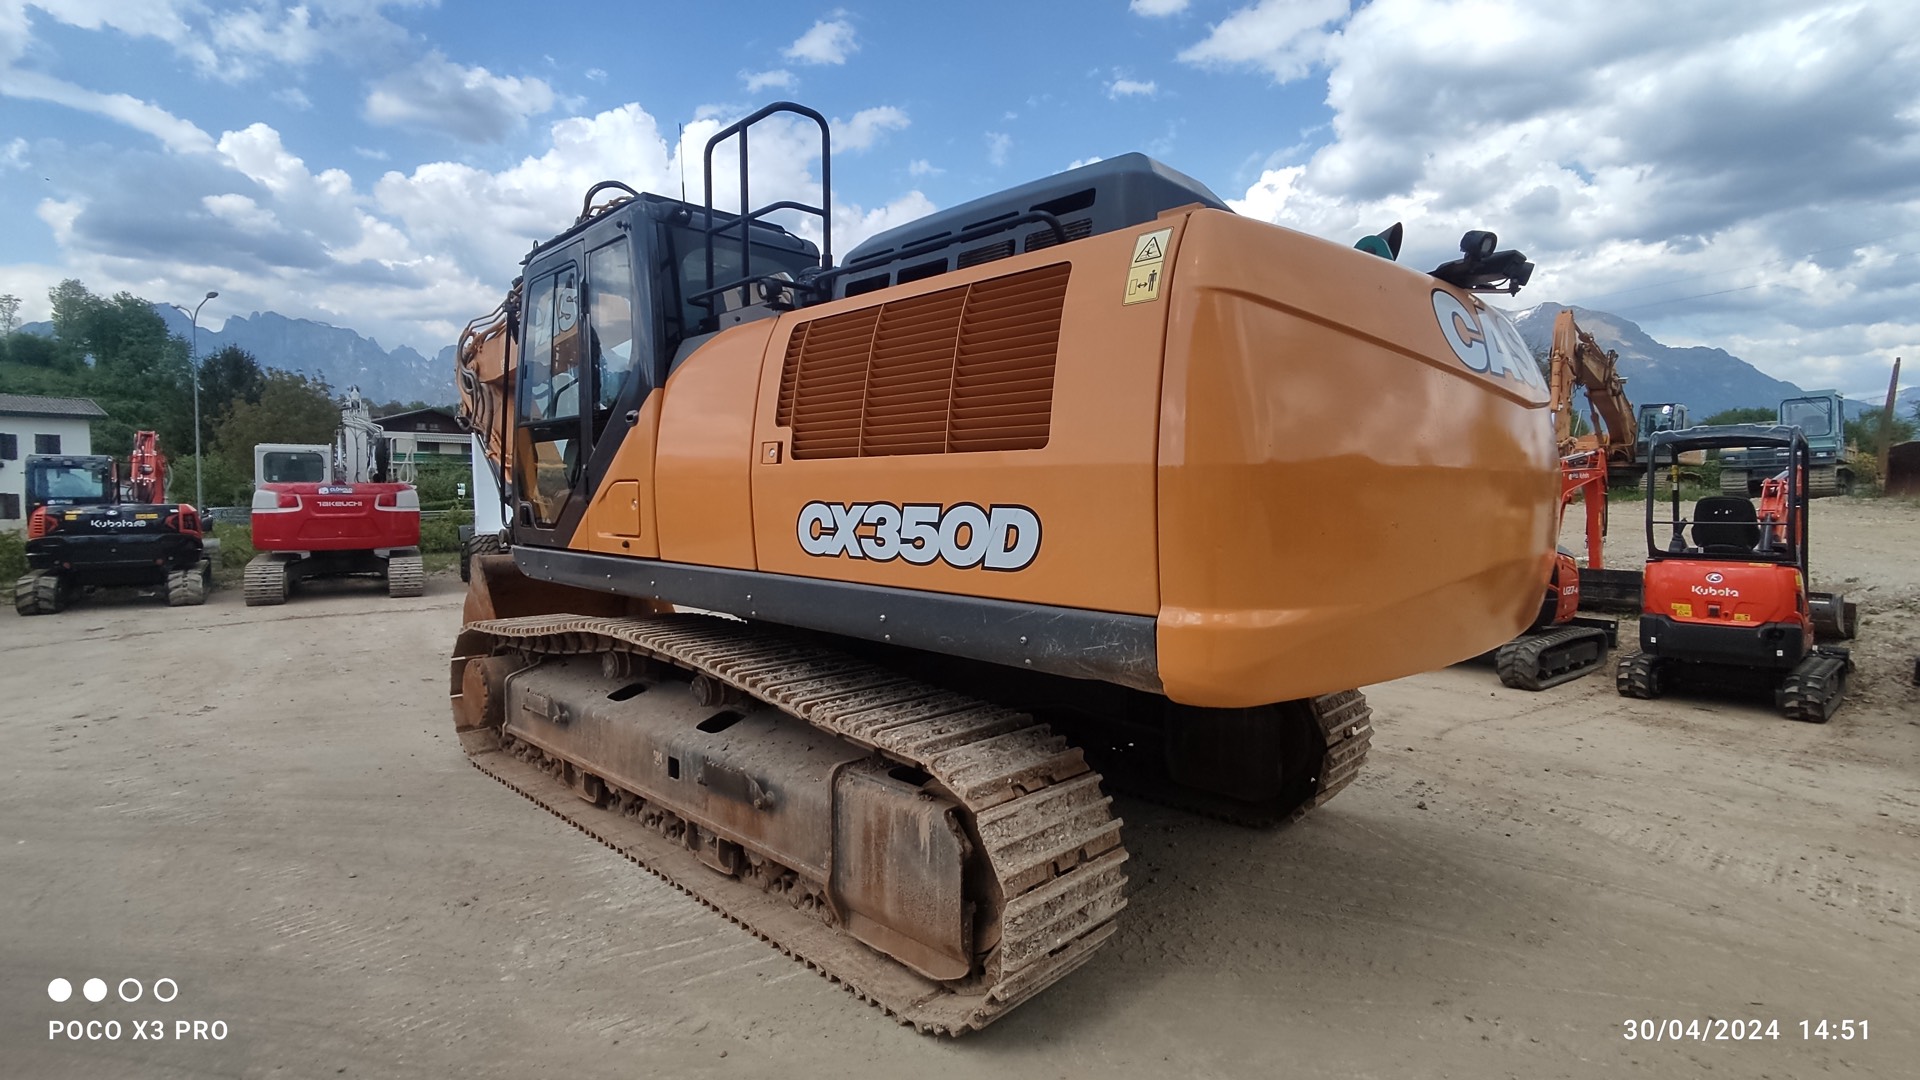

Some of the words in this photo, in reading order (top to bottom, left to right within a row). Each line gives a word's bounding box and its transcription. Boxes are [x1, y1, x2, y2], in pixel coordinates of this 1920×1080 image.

[90, 519, 135, 528] Kubota
[797, 500, 1042, 573] CX350D
[1691, 585, 1739, 597] Kubota
